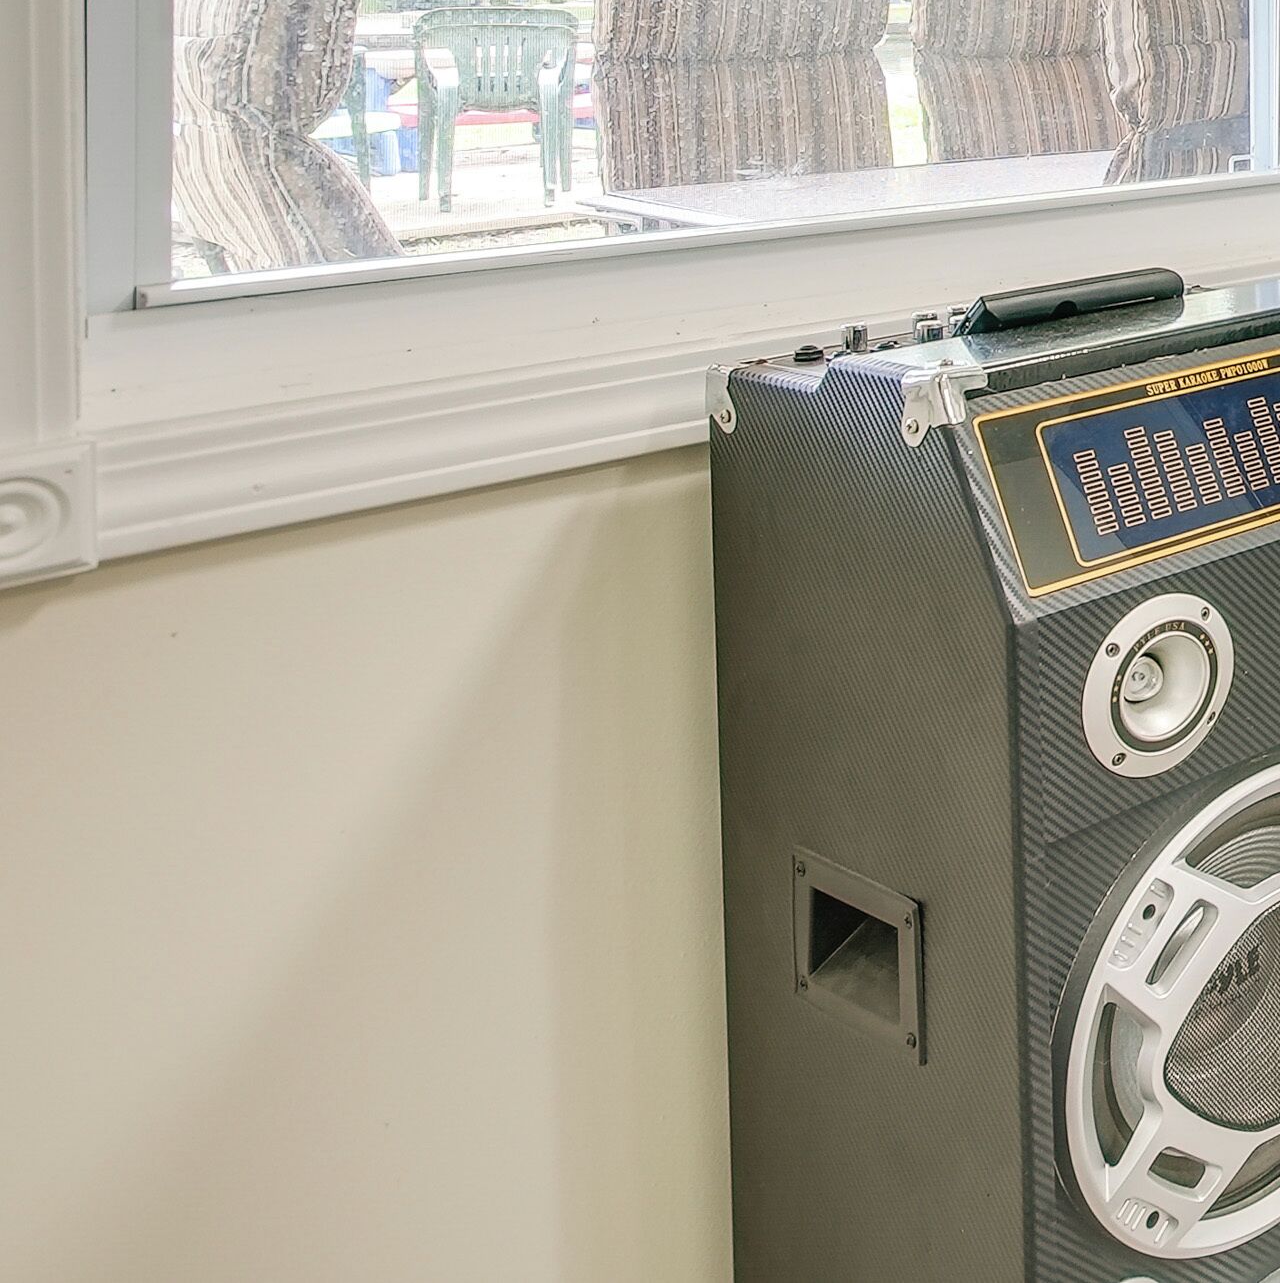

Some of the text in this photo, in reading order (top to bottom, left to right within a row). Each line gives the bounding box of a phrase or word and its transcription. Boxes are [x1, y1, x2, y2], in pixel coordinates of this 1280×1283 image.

[1145, 380, 1178, 396] SUPER
[1178, 370, 1220, 389] KARAOKE
[1165, 621, 1185, 632] USA
